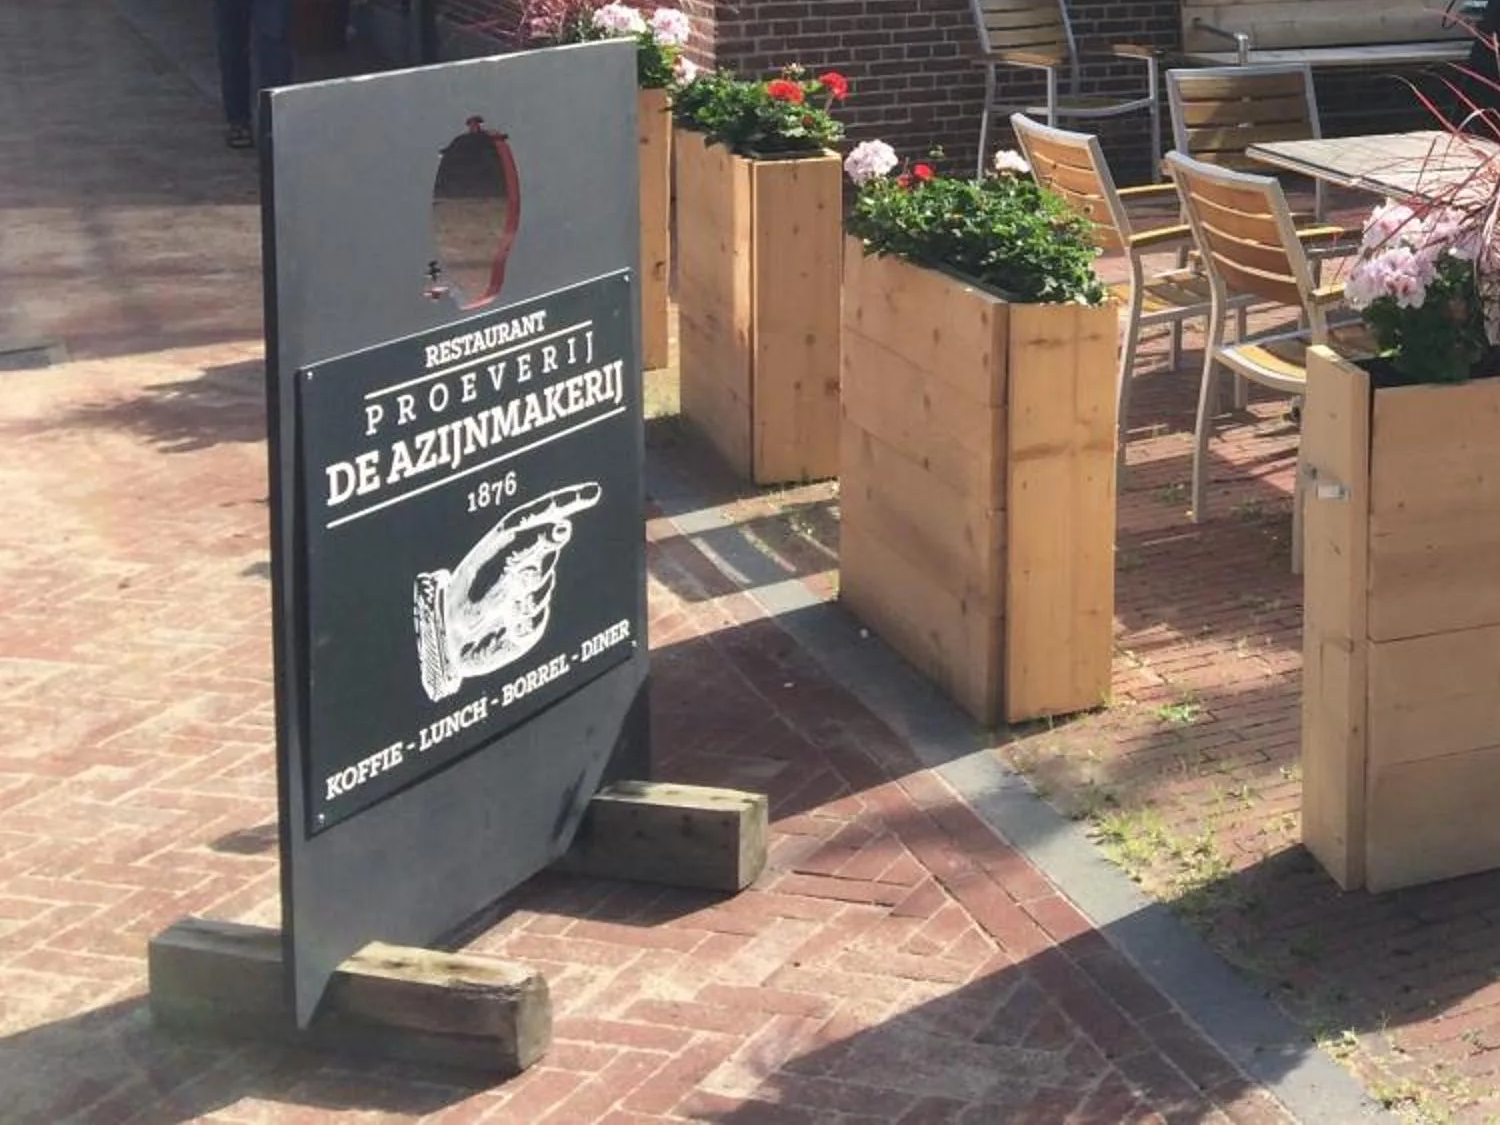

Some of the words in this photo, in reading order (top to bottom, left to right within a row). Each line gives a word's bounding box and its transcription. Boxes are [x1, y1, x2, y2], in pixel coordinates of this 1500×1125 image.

[365, 331, 593, 436] PROEVERIJ
[425, 310, 547, 368] RESTAURANT
[325, 450, 381, 507] DE
[386, 360, 624, 484] AZIJNMAKERIJ
[467, 471, 518, 512] 1876
[325, 742, 403, 800] KOFFIE
[419, 697, 488, 751] LUNCH
[502, 653, 570, 707] BORREL
[581, 619, 630, 662] DINER
